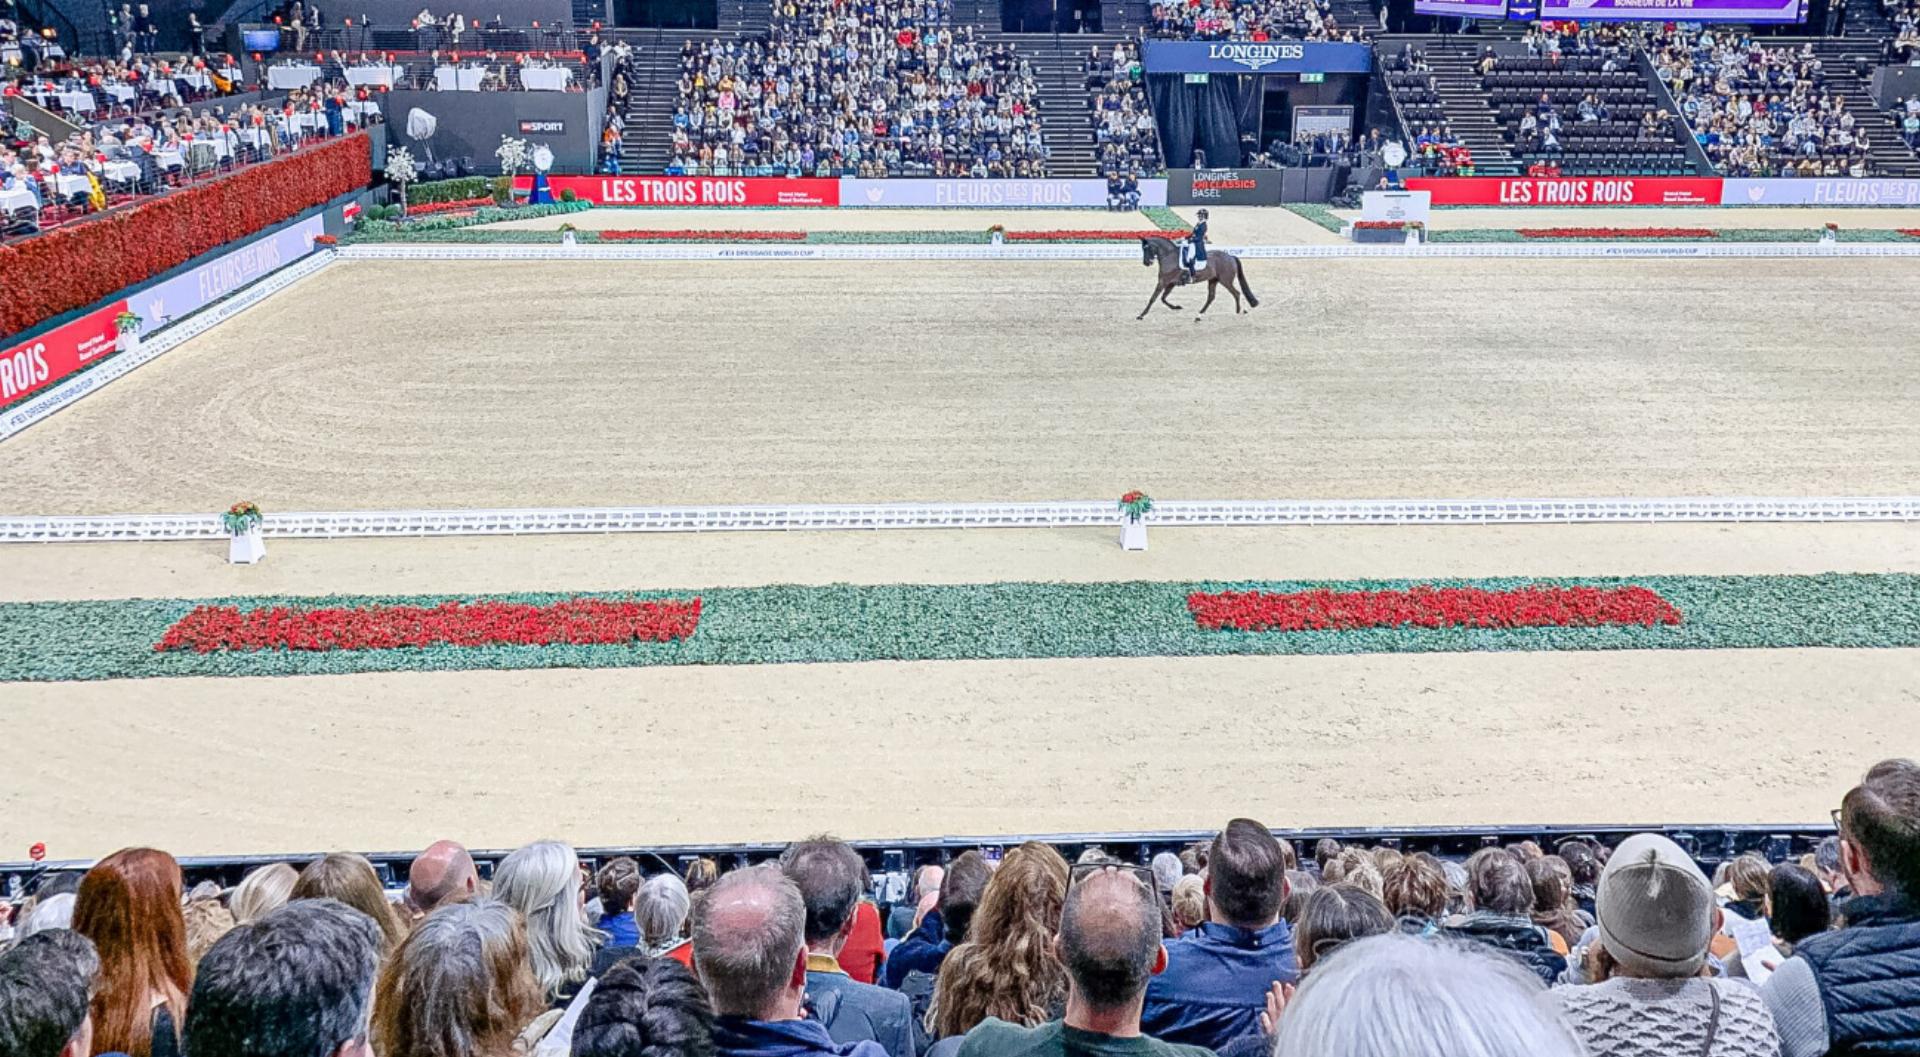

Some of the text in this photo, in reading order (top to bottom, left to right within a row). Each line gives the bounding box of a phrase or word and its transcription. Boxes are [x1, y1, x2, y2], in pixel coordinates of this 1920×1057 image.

[1209, 44, 1303, 59] LONGINES
[531, 122, 563, 131] SPORT
[1193, 172, 1239, 181] LONGINES
[1209, 180, 1257, 189] CLASSICS
[602, 180, 746, 202] LES TROIS ROIS
[935, 182, 1072, 204] FLEURS DES ROIS
[1192, 188, 1221, 198] BASEL
[1500, 181, 1634, 203] LES TROIS ROIS
[1814, 182, 1878, 203] FLEURS
[1882, 181, 1904, 195] DES
[200, 255, 243, 302] FLEURS
[256, 238, 281, 272] ROIS
[1, 342, 49, 399] ROIS
